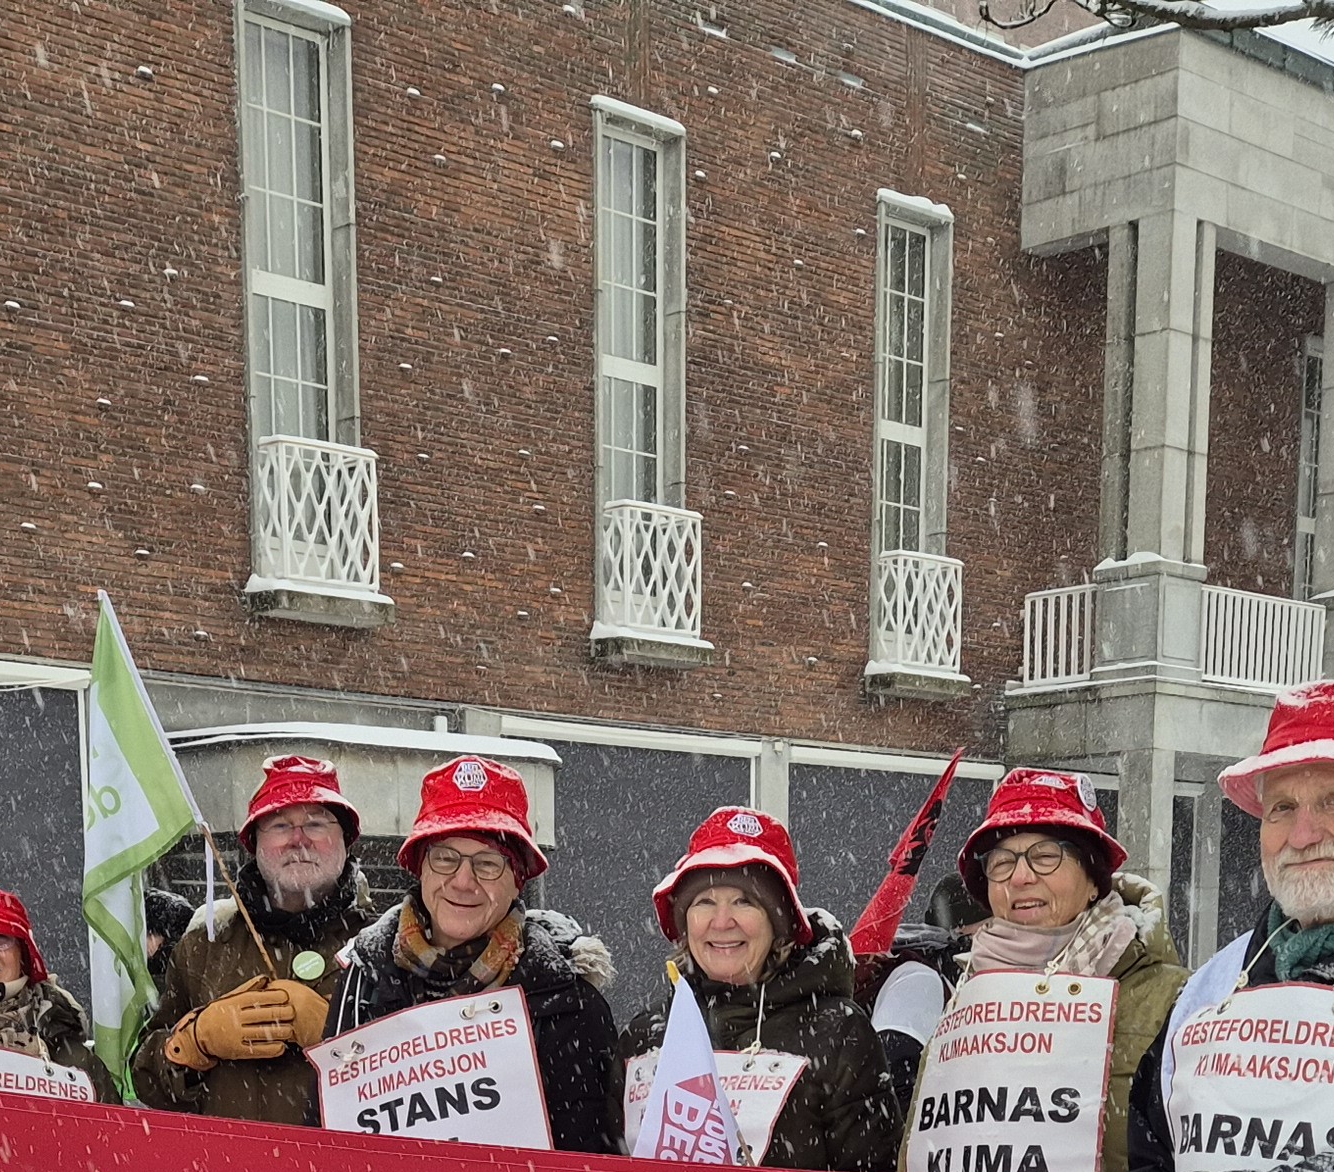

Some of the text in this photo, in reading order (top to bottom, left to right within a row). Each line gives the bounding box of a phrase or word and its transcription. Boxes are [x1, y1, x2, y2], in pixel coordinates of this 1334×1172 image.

[328, 1018, 518, 1088] BESTEFORELDRENES
[938, 1032, 1053, 1064] KLIMAAKSJON
[357, 1050, 488, 1103] KLIMAAKSJON
[356, 1076, 501, 1135] STANS
[918, 1086, 1081, 1132] BARNAS
